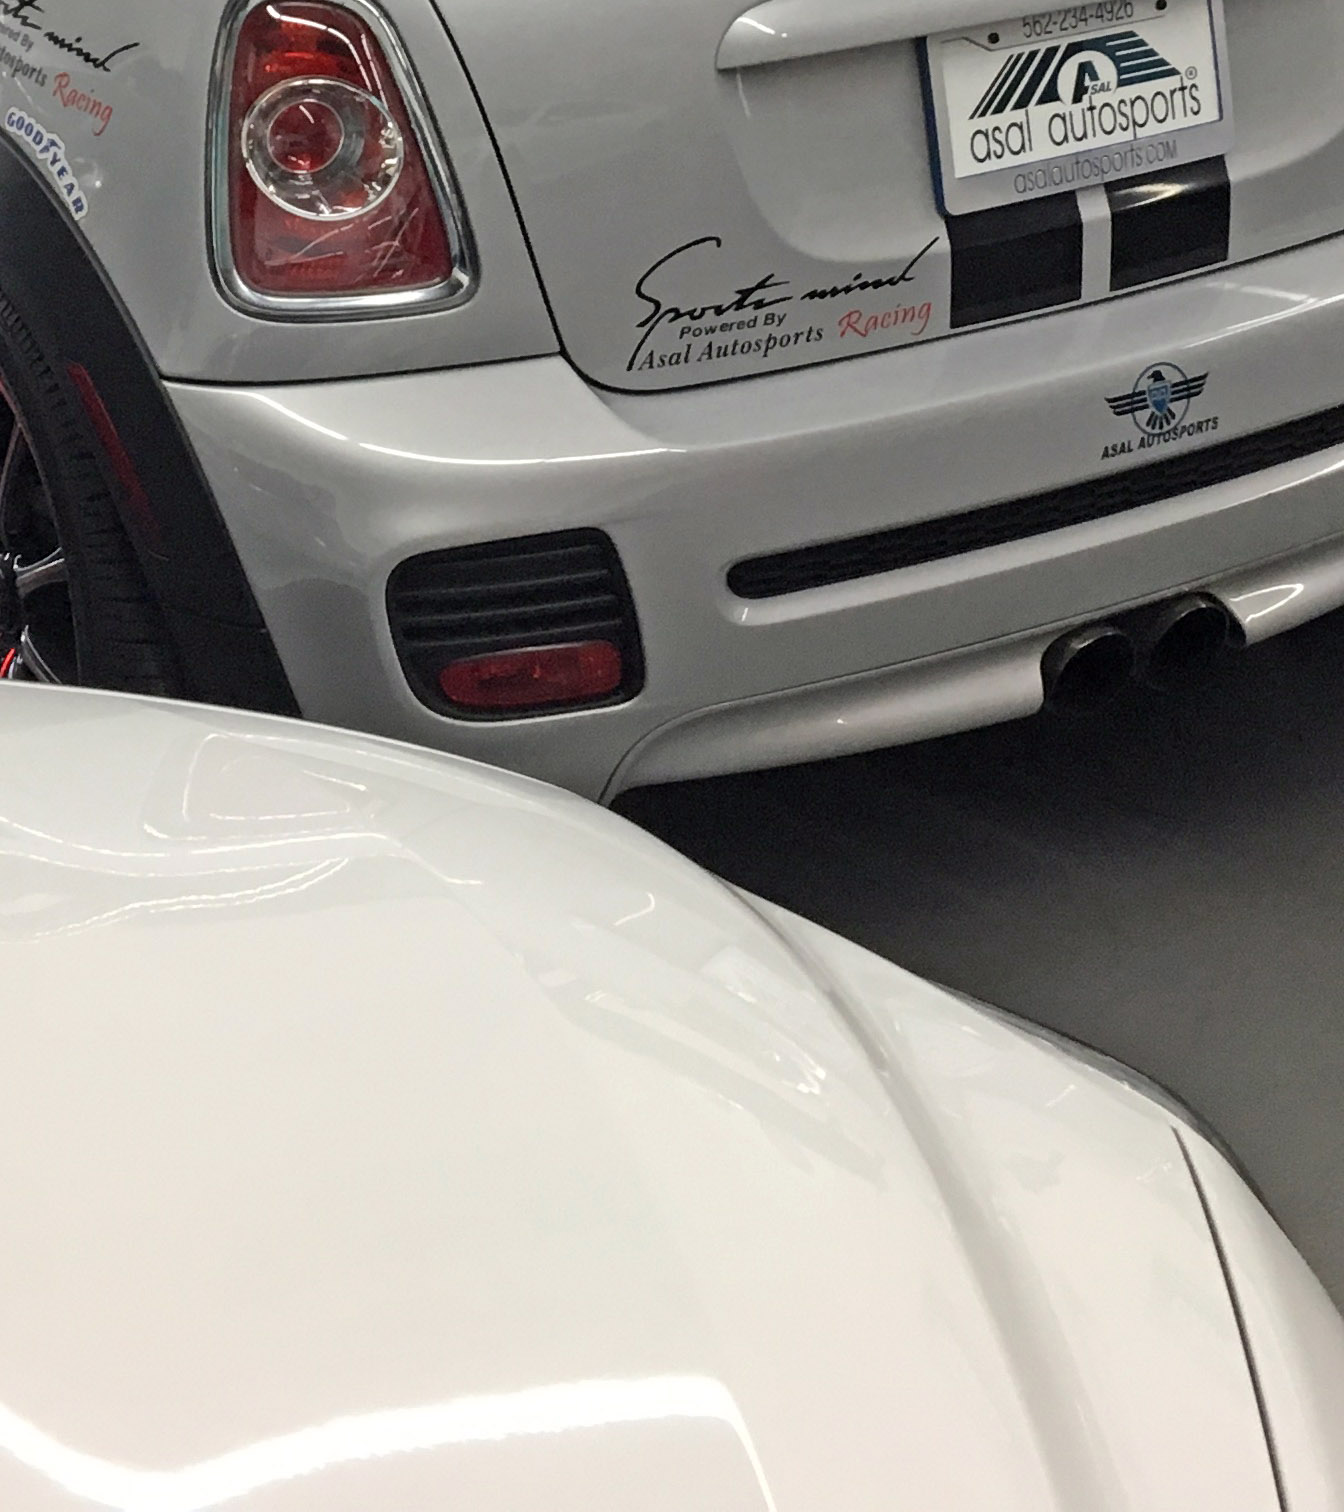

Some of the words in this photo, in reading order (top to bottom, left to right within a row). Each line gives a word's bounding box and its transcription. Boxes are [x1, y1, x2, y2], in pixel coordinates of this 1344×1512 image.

[21, 33, 35, 52] By
[53, 72, 113, 136] Racing
[970, 109, 1033, 163] asal
[1048, 76, 1202, 146] autosports
[7, 112, 84, 214] GOODYEAR
[626, 236, 793, 371] Sports
[801, 237, 940, 300] mind
[638, 343, 692, 371] Asal
[697, 325, 824, 363] Autosports
[838, 302, 932, 337] Racing
[679, 315, 757, 339] Powered
[763, 312, 787, 329] By
[1100, 441, 1134, 461] ASAL
[1138, 416, 1219, 450] AUTOSPORTS
